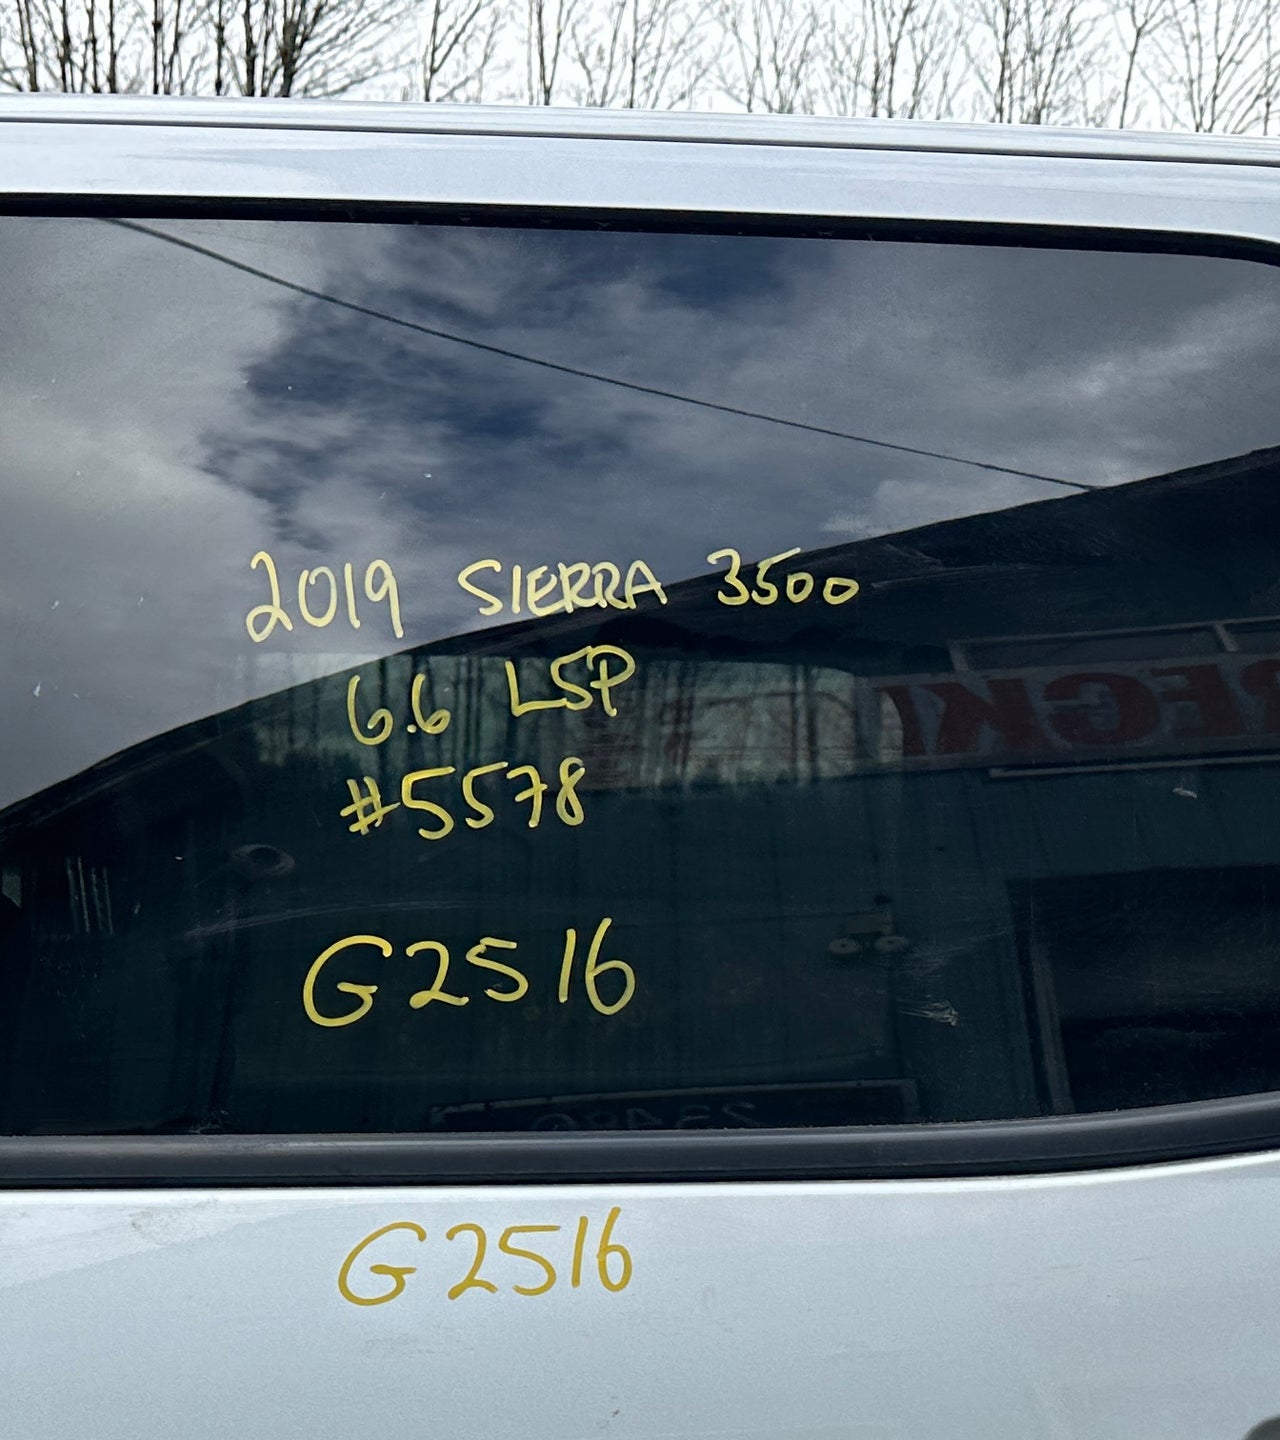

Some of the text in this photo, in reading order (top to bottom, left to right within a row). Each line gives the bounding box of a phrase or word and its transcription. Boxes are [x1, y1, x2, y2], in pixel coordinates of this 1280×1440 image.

[246, 548, 859, 641] 2019 SIERRA 3500
[347, 673, 451, 745] 6.6
[340, 757, 586, 840] #5578
[303, 918, 636, 1027] G2516
[337, 1206, 633, 1306] G2516
